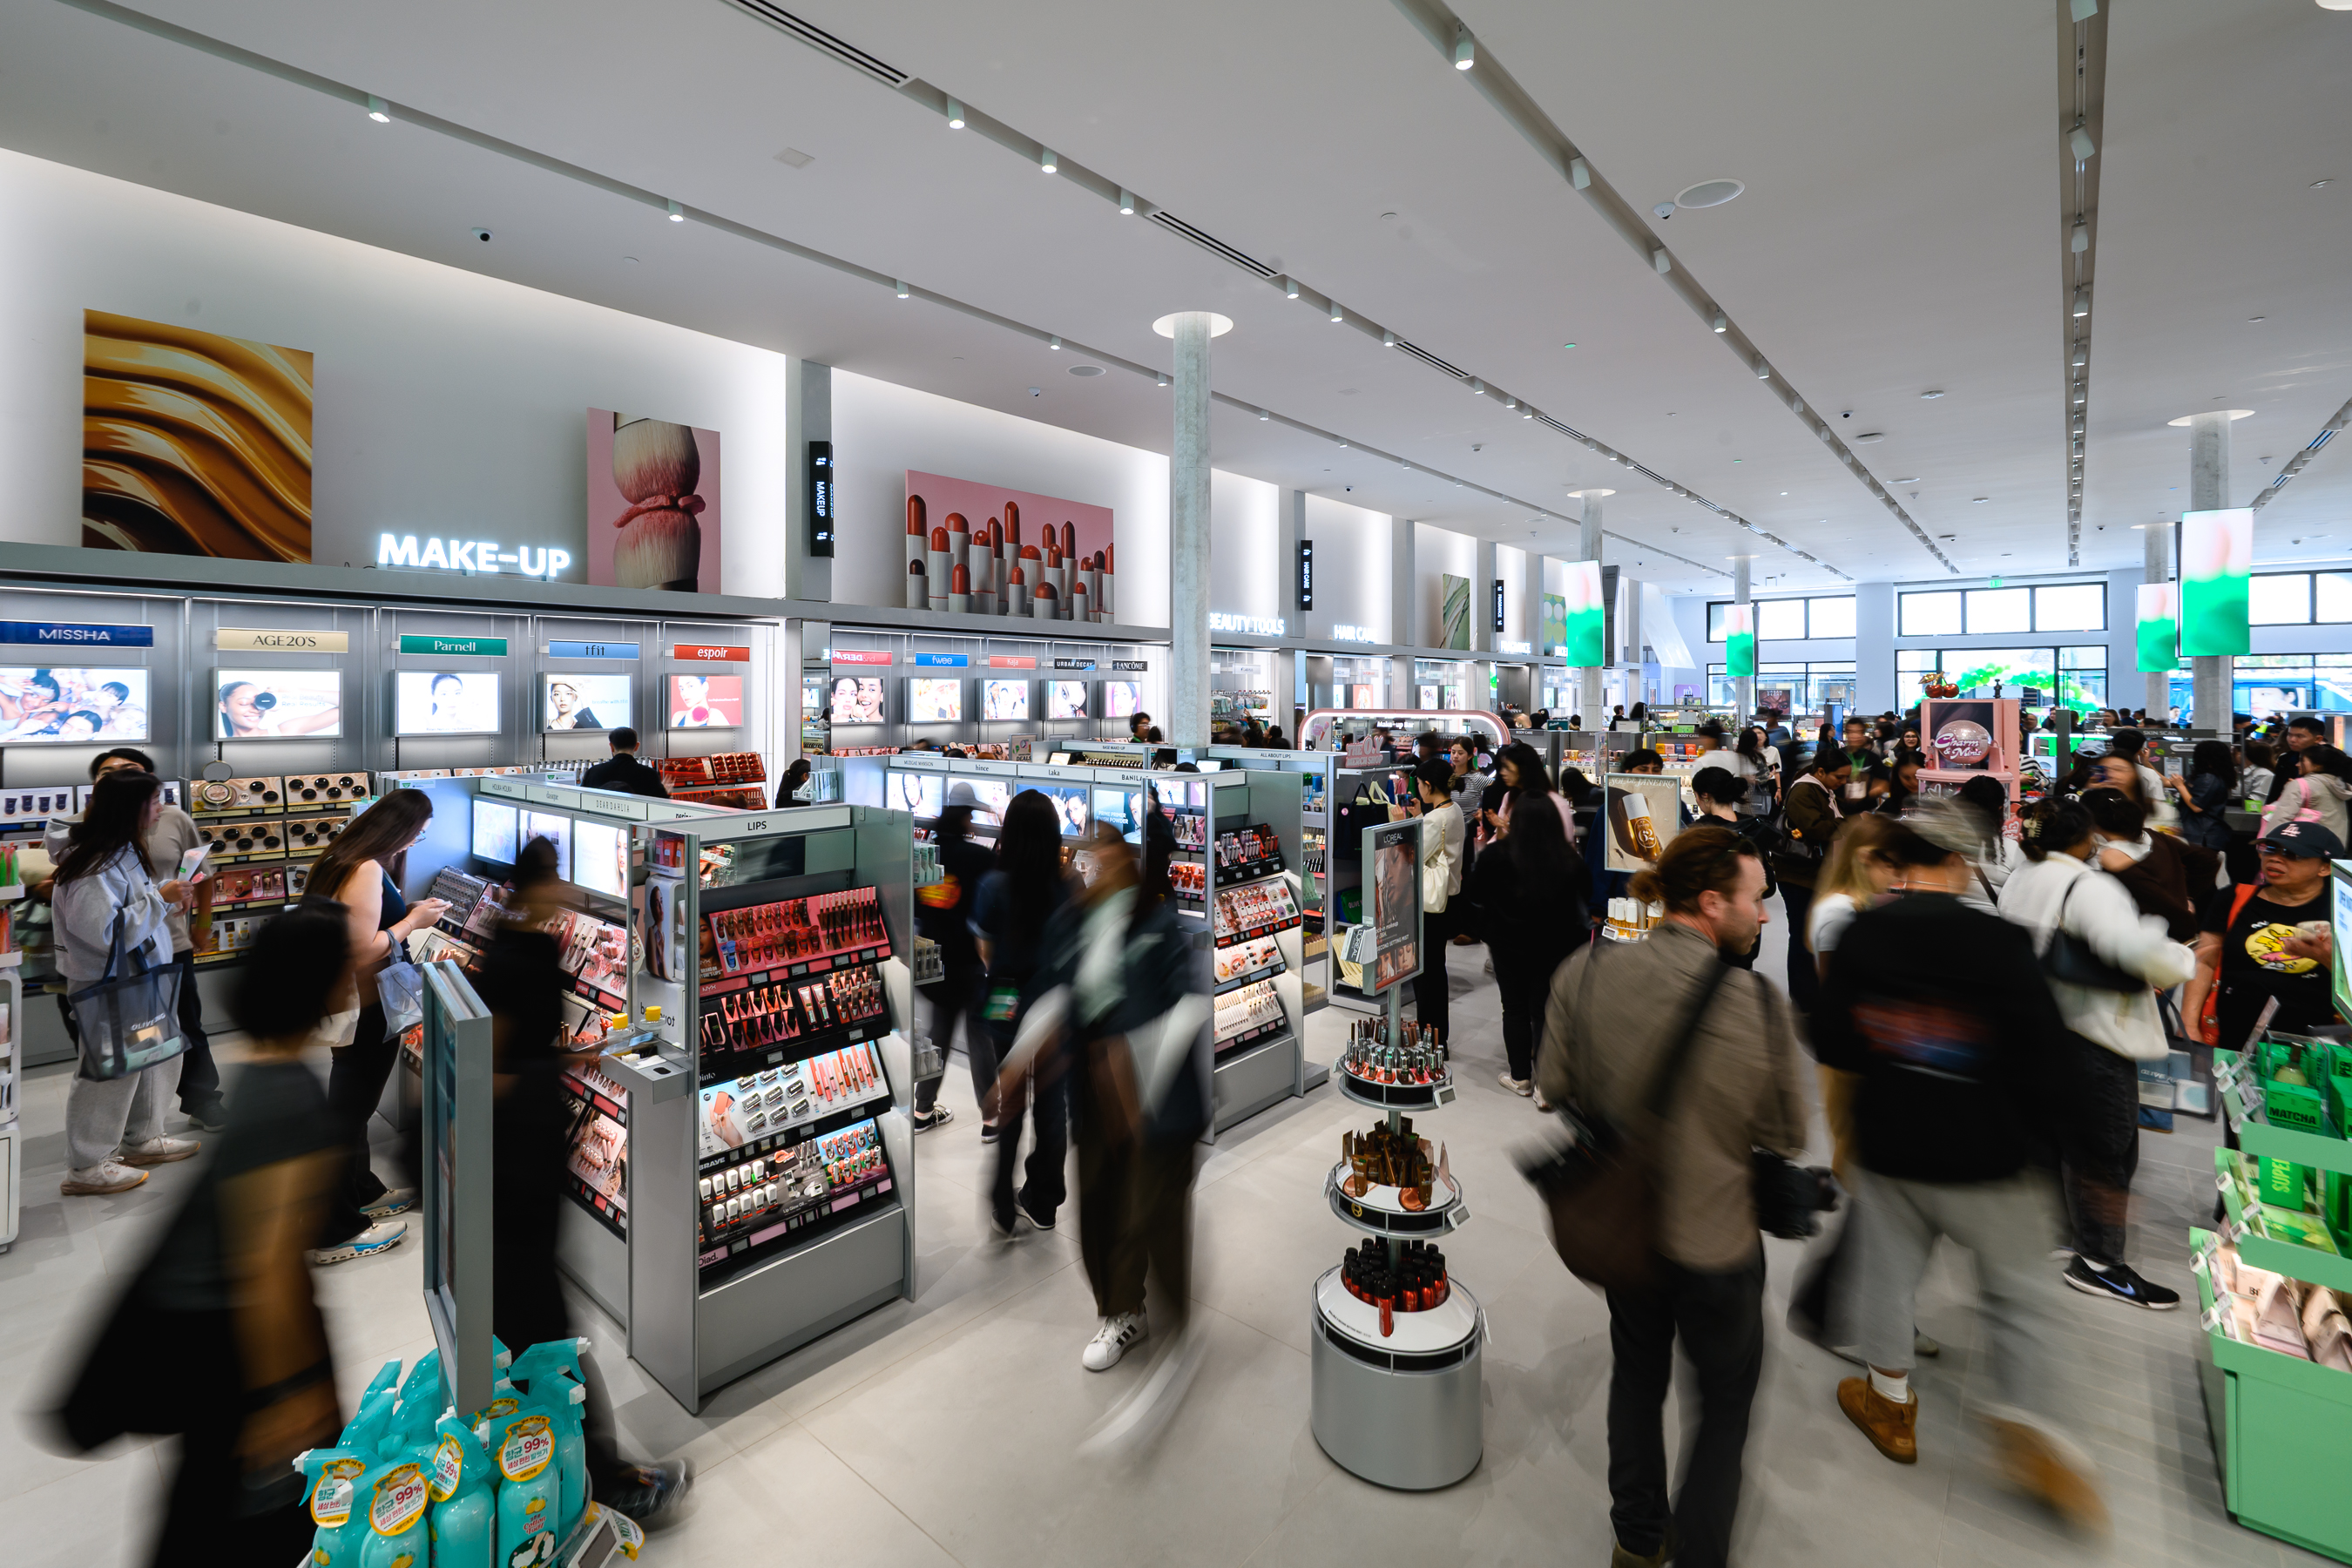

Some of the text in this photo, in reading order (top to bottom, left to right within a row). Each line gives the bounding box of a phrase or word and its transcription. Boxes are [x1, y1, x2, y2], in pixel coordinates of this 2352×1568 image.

[816, 482, 826, 517] MAKEUP
[378, 533, 571, 577] MAKE-UP
[1209, 612, 1285, 635] BEAUTY TOOLS
[38, 628, 112, 642] MISSHA
[1334, 625, 1356, 641] HAIR
[253, 635, 316, 647] AGE20'S
[434, 640, 476, 652] Parnell
[585, 645, 605, 656] tfit
[697, 647, 728, 660] espoir
[932, 656, 953, 665] fwee
[1117, 661, 1144, 670] LANCÔME
[1376, 720, 1403, 729] Make-up
[1935, 733, 1979, 748] Charm
[1348, 745, 1362, 756] THE
[1950, 747, 1982, 760] Minis
[1347, 754, 1383, 767] MERCH SHOP
[1610, 777, 1625, 786] SOL
[1635, 779, 1676, 789] JANEIRO
[596, 799, 630, 813] DEAR DAHLIA
[747, 821, 767, 831] LIPS
[1639, 828, 1655, 842] 62
[132, 1019, 155, 1031] OLIVE
[2268, 1106, 2317, 1125] MATCHA
[505, 1437, 549, 1462] 항균 99%
[507, 1459, 518, 1470] 세상
[519, 1455, 530, 1464] 편한
[444, 1461, 457, 1480] 99%
[318, 1488, 336, 1501] 항균
[375, 1498, 395, 1518] 항균
[395, 1484, 422, 1505] 99%
[317, 1503, 328, 1511] 세상
[380, 1512, 392, 1526] 세상
[392, 1506, 404, 1517] 편한
[524, 1516, 546, 1531] Cotton
